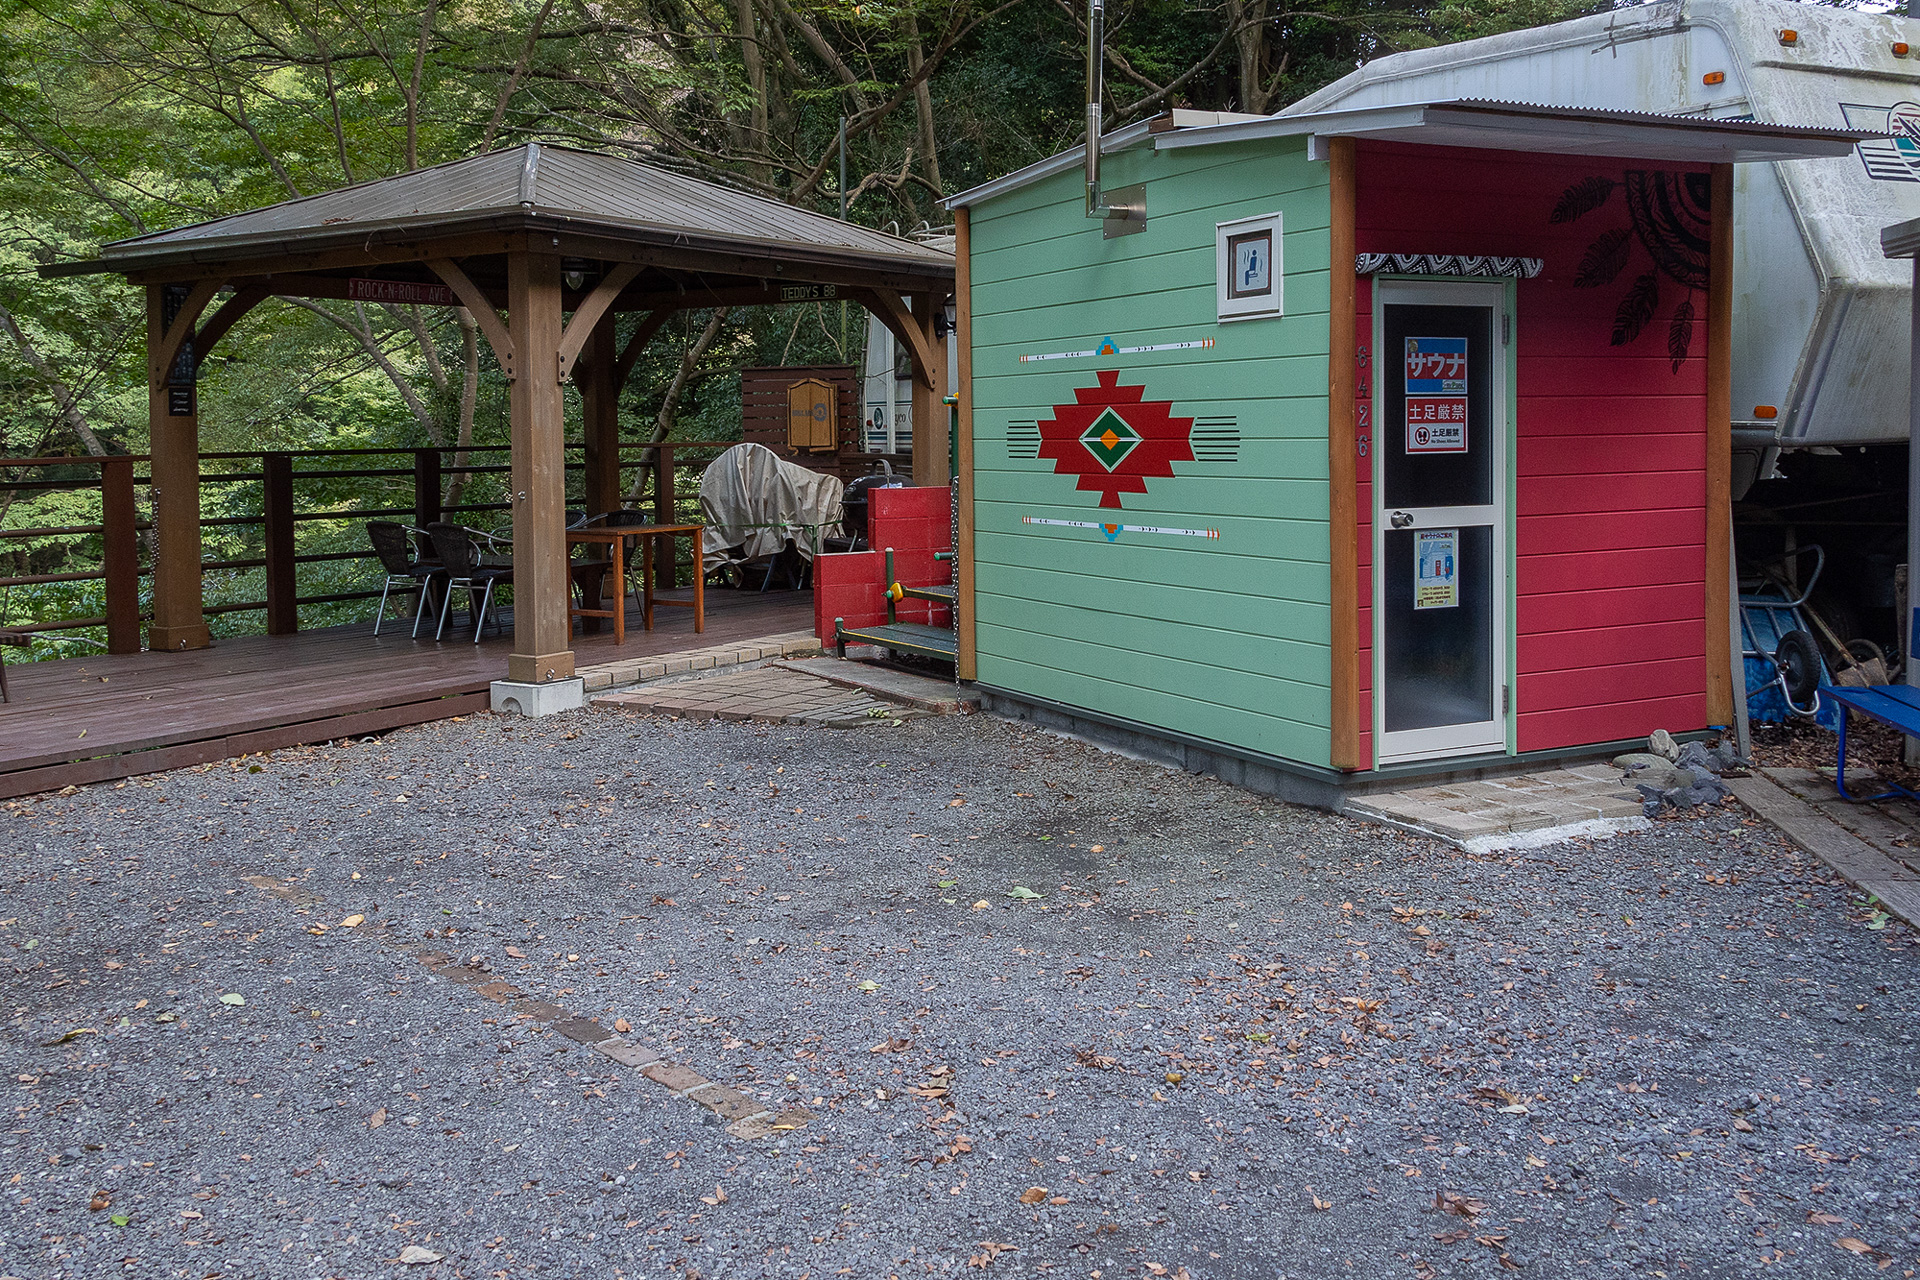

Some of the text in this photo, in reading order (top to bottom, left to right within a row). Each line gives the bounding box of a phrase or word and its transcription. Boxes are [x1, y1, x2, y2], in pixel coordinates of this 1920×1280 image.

[357, 281, 446, 303] ROCK-N-ROLL AVE
[823, 285, 836, 297] 88
[1407, 352, 1465, 378] サウナ
[1357, 345, 1369, 458] 6426
[1408, 404, 1465, 420] 土足厳禁
[1431, 428, 1460, 437] 土足厳禁
